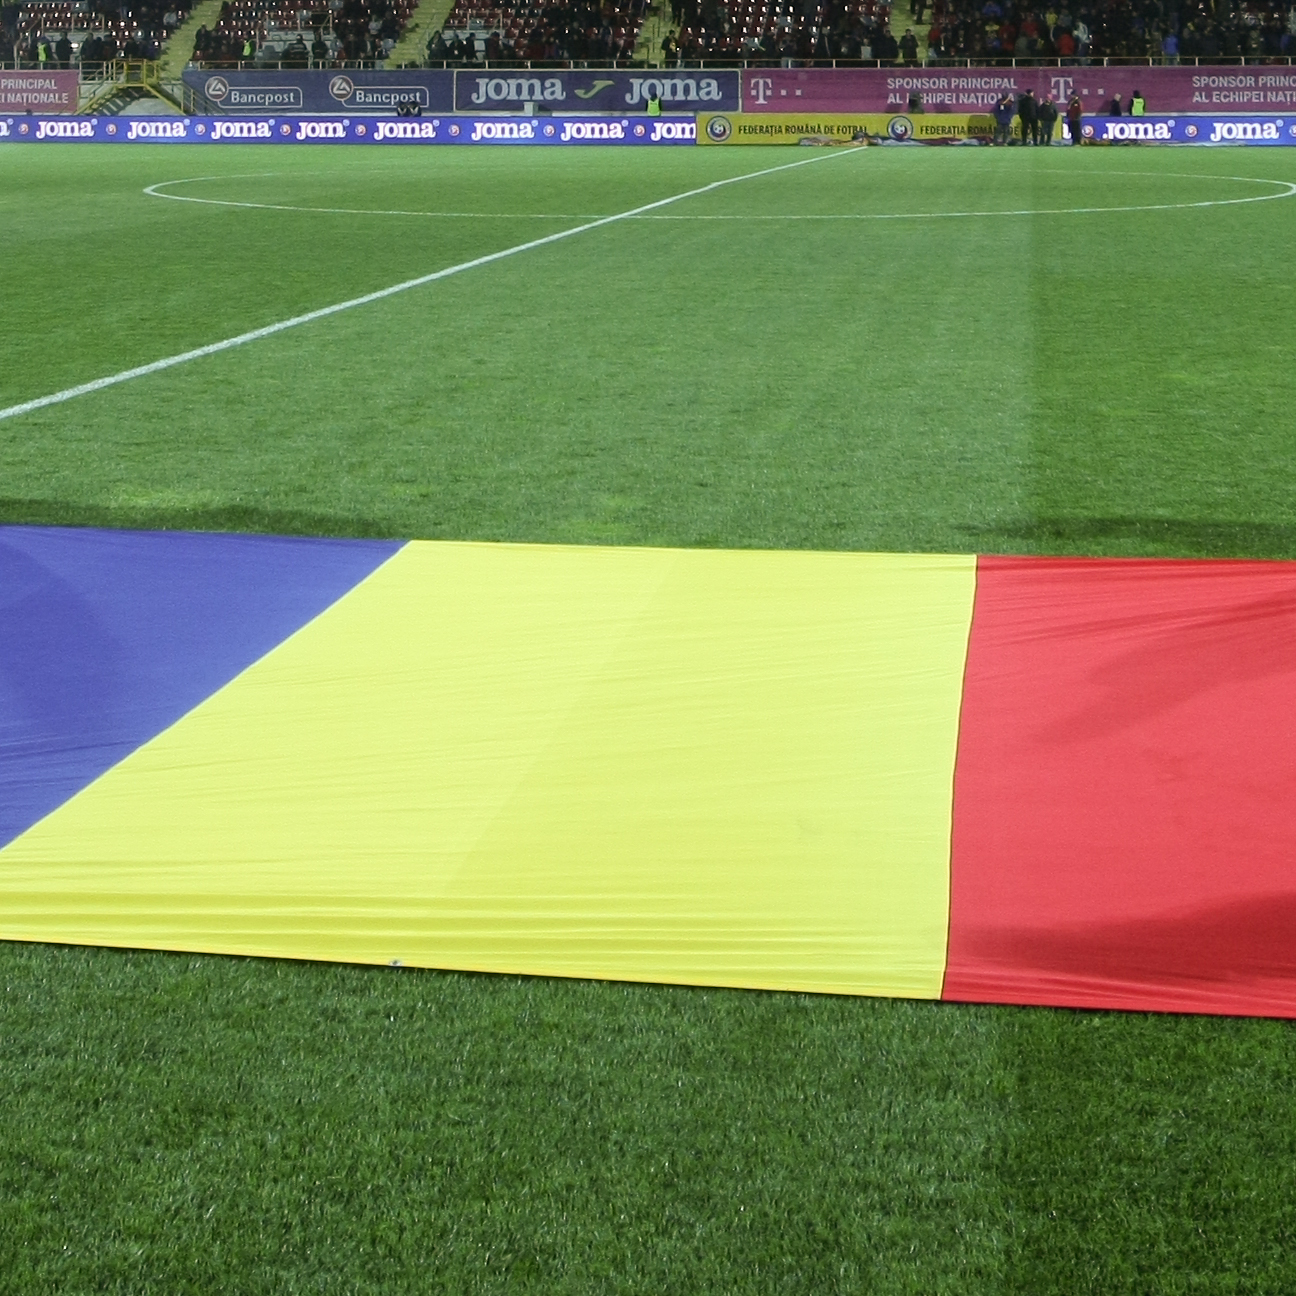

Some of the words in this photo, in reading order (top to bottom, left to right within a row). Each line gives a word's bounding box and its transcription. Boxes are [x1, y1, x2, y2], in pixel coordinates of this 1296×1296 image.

[1, 78, 58, 90] PRINCIPAL
[887, 77, 948, 89] SPONSOR
[951, 77, 1017, 89] PRINCIPAL
[1192, 76, 1254, 88] SPONSOR
[230, 90, 295, 106] Bancpost
[356, 90, 421, 106] Bancpost
[887, 93, 903, 104] AL
[1192, 91, 1209, 103] AL
[1212, 91, 1262, 103] ECHIPEI
[824, 125, 836, 135] DE
